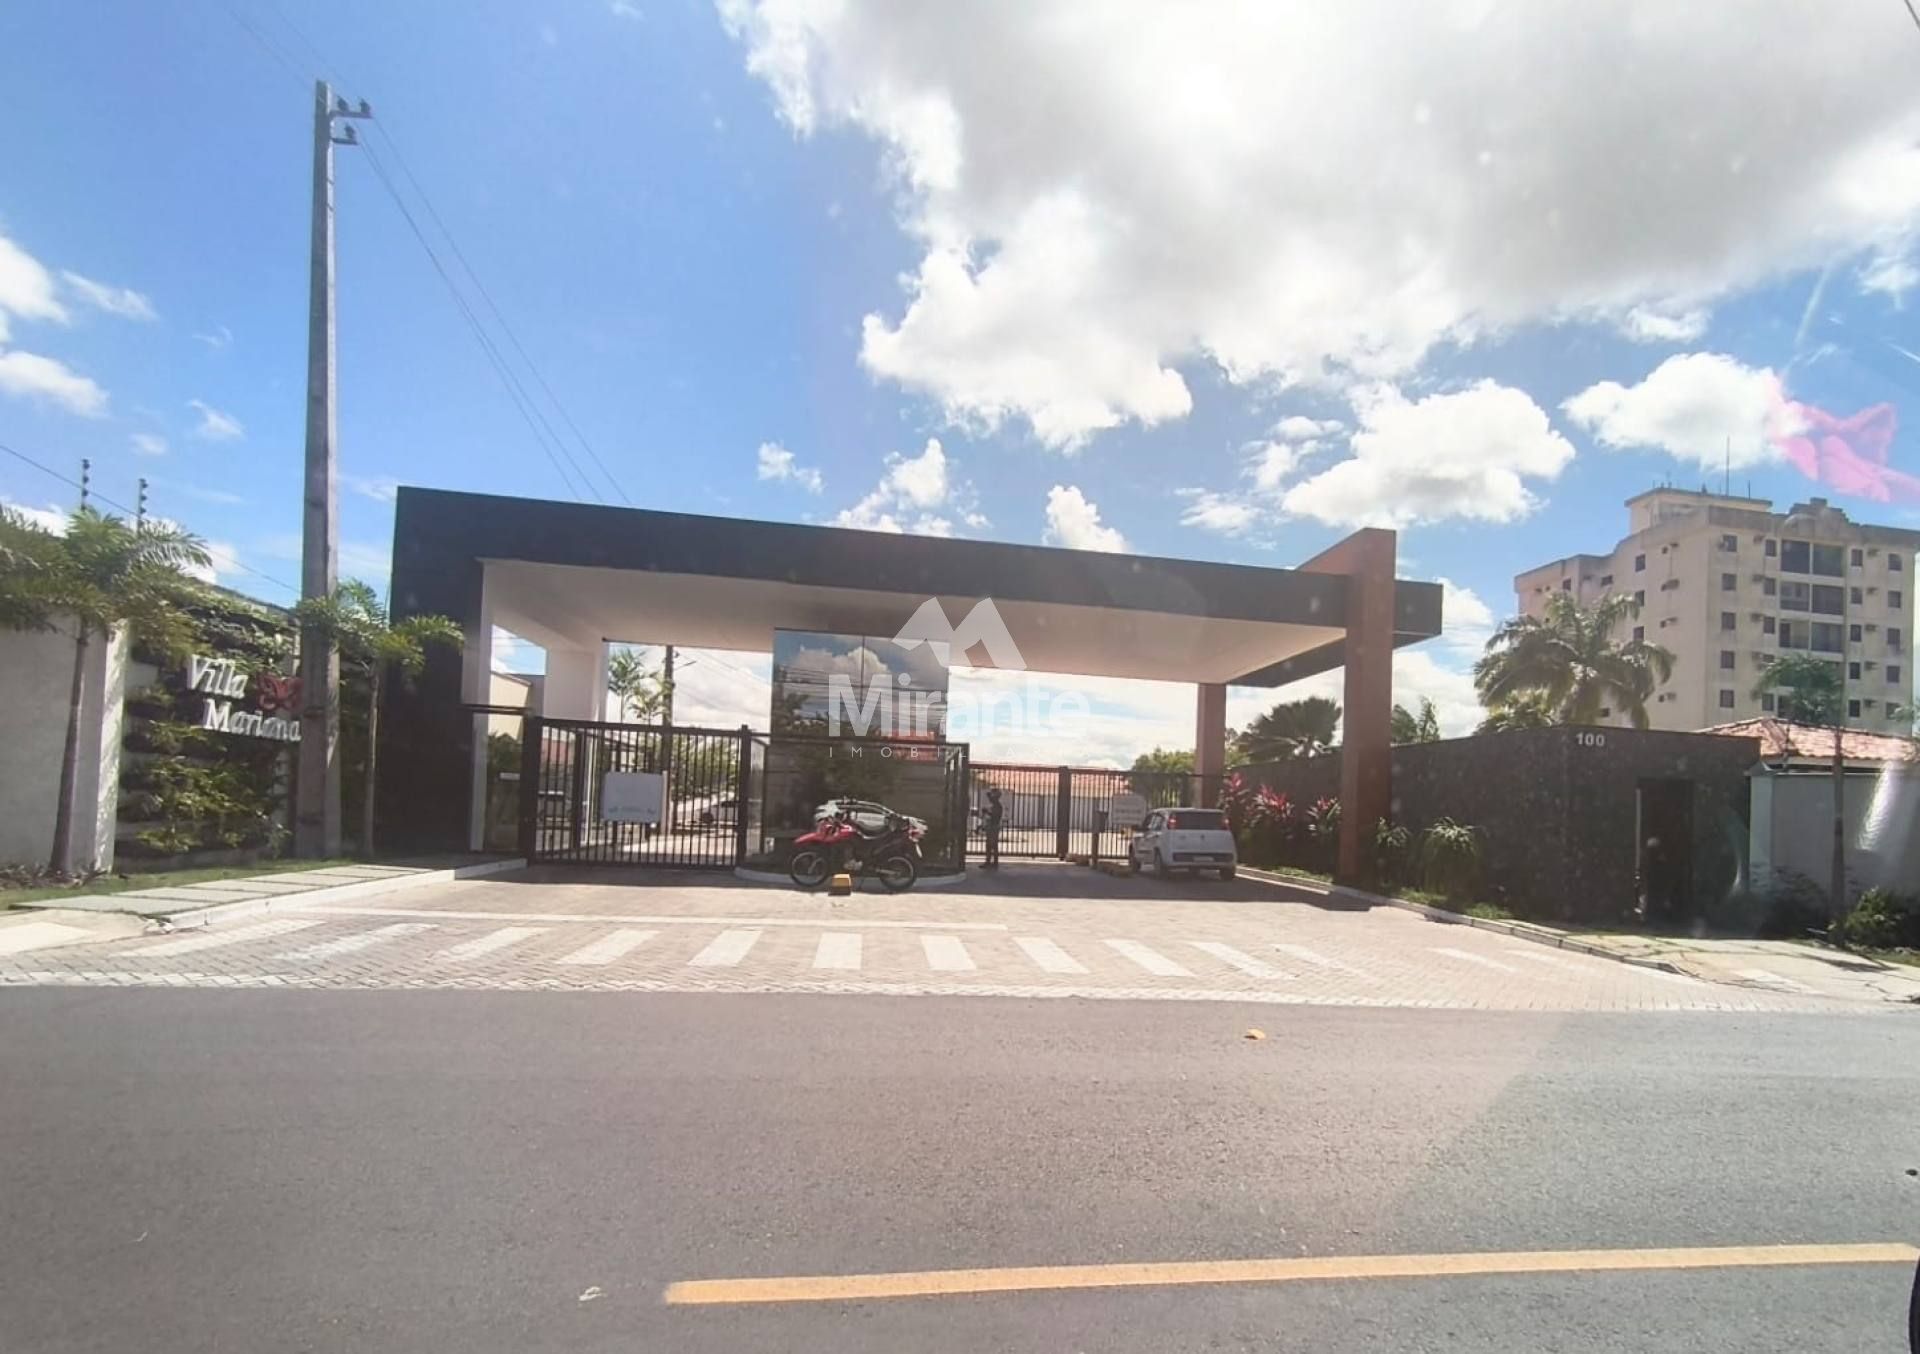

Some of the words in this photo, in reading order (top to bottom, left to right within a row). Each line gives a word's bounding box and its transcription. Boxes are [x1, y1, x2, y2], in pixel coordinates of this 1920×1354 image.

[187, 654, 249, 699] Villa
[203, 698, 302, 742] Mariana
[1575, 731, 1606, 747] 100
